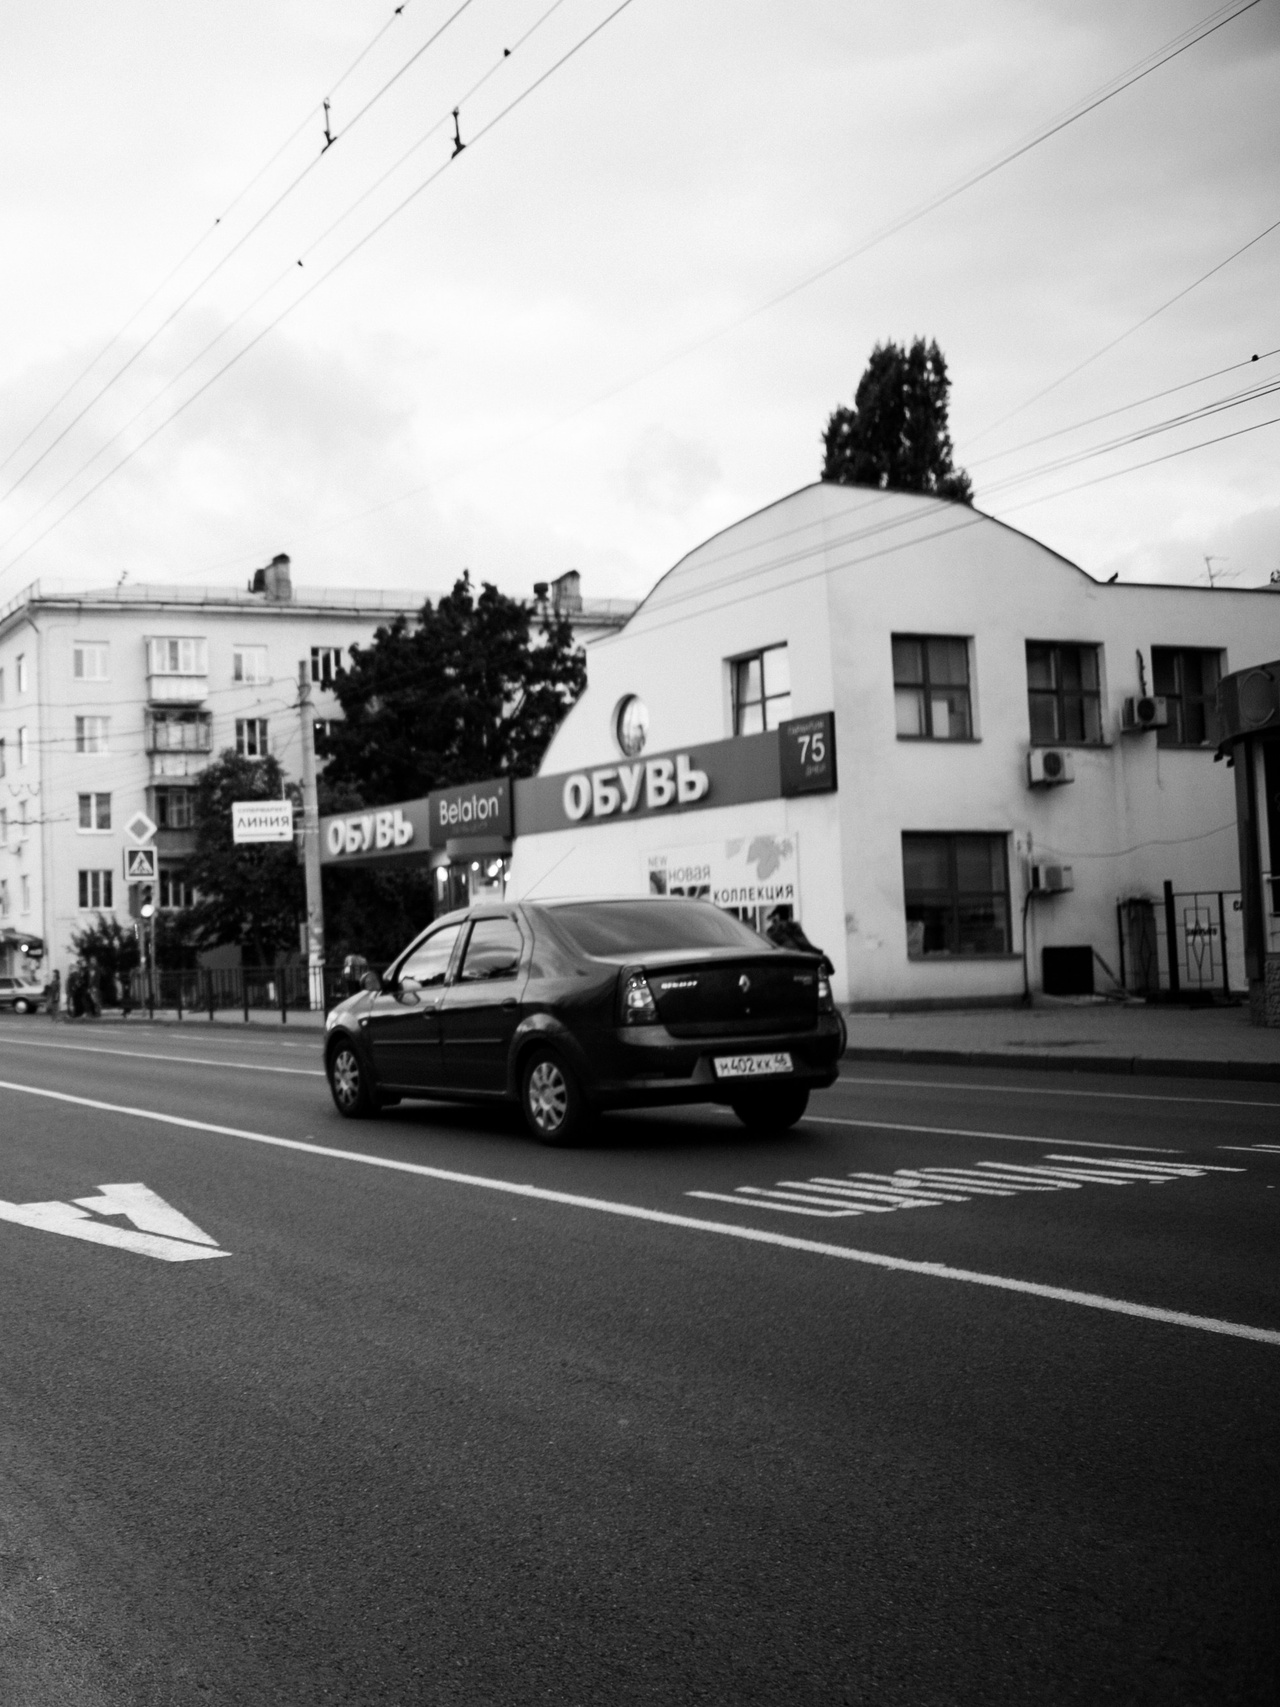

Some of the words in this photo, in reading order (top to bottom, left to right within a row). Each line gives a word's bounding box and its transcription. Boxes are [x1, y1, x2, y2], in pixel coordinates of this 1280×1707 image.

[797, 732, 826, 765] 75
[562, 753, 709, 821] ОБУВЬ
[237, 815, 290, 829] ЛИНИЯ
[439, 794, 499, 826] Belaton
[327, 808, 414, 856] ОБУВЬ
[648, 856, 668, 867] NEW
[713, 883, 794, 904] КОЛЛЕКЦИЯ
